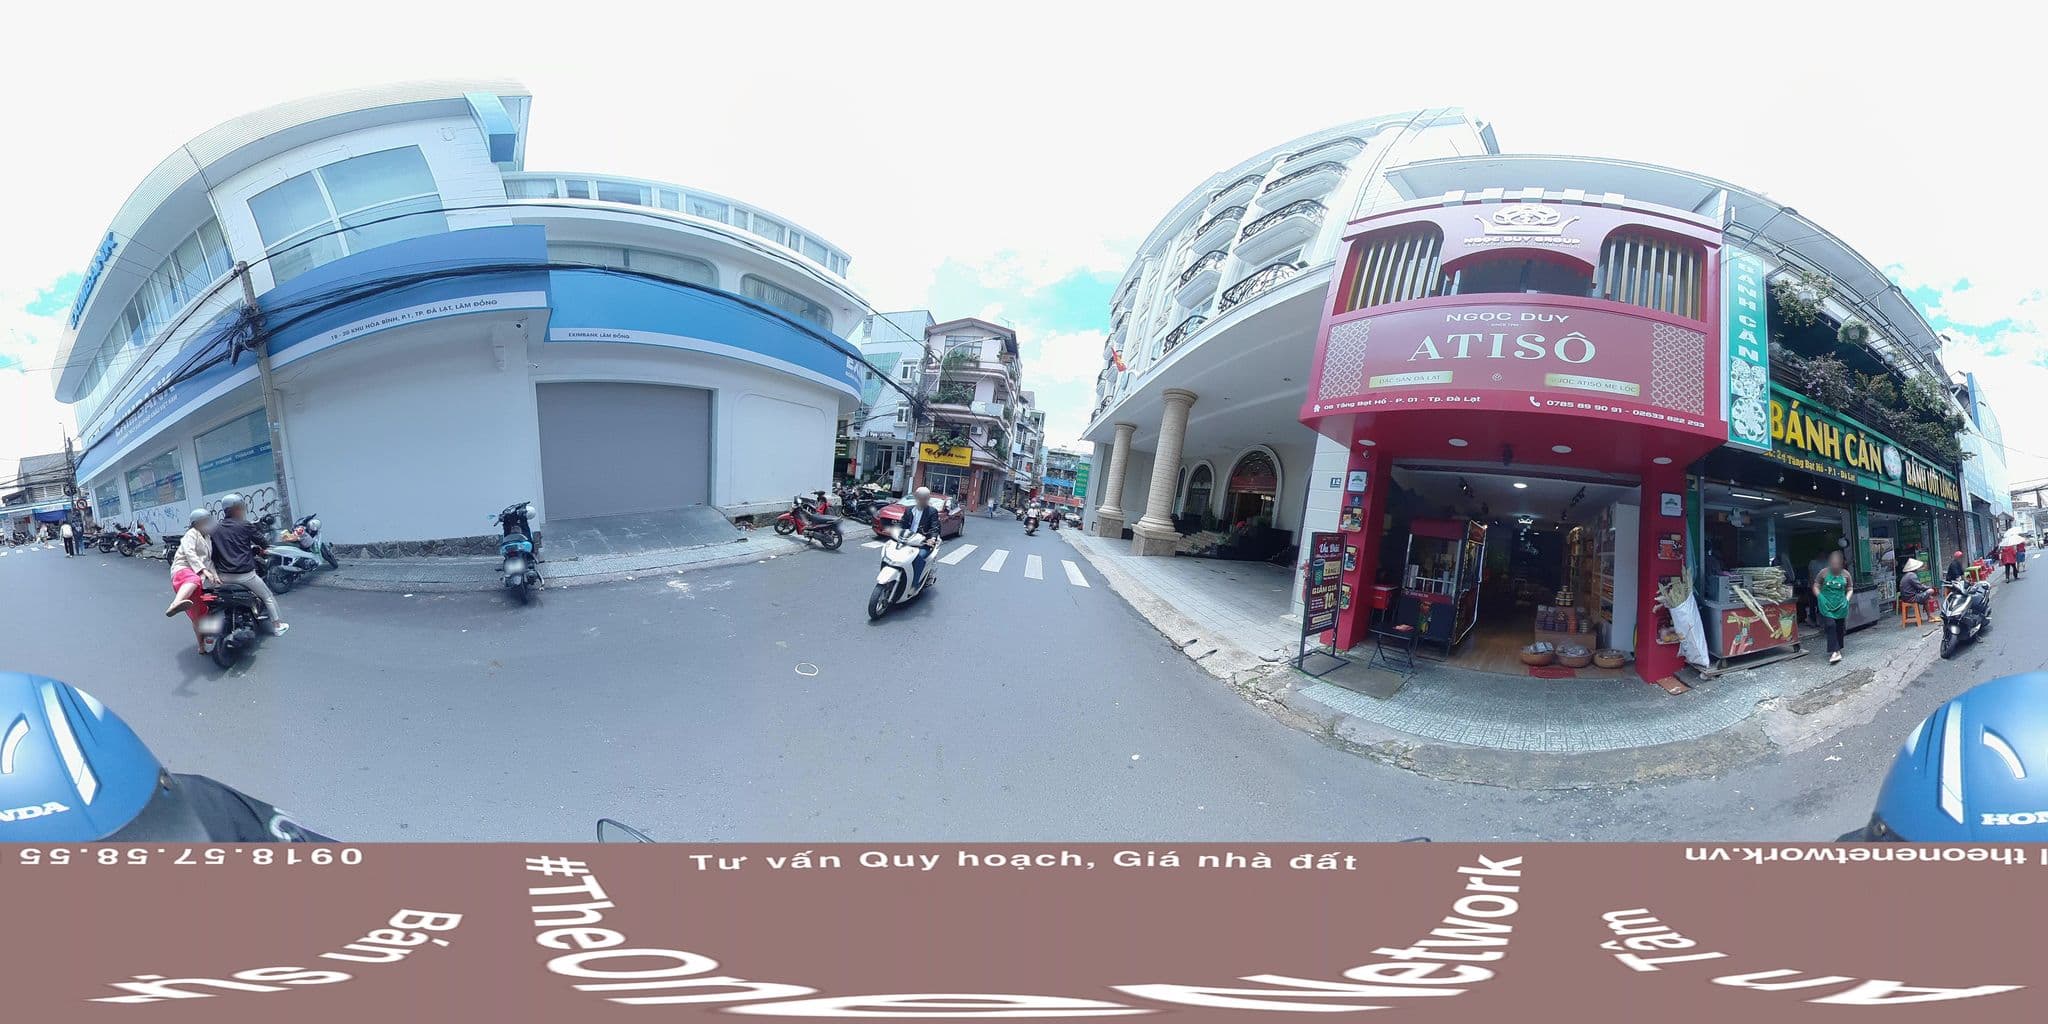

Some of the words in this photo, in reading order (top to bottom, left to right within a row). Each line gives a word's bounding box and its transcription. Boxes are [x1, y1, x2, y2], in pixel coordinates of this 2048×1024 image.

[1502, 234, 1533, 242] DUY
[1534, 235, 1581, 245] GROUP
[365, 320, 380, 329] HÒA
[426, 307, 438, 315] ĐÀ
[455, 301, 472, 309] LÂM
[473, 298, 498, 307] ĐỒNG
[1446, 312, 1512, 323] NGỌC
[1520, 312, 1570, 323] DUY
[1407, 331, 1597, 364] ATISÔ
[1446, 394, 1461, 402] Đà
[1546, 399, 1574, 408] 0785
[1577, 402, 1592, 410] 89
[1594, 404, 1608, 412] 90
[1610, 406, 1622, 414] 91
[1632, 409, 1665, 420] 02633
[1771, 400, 1841, 460] BÁNH
[1844, 430, 1883, 475] CĂN
[1905, 456, 1928, 491] BÁNH
